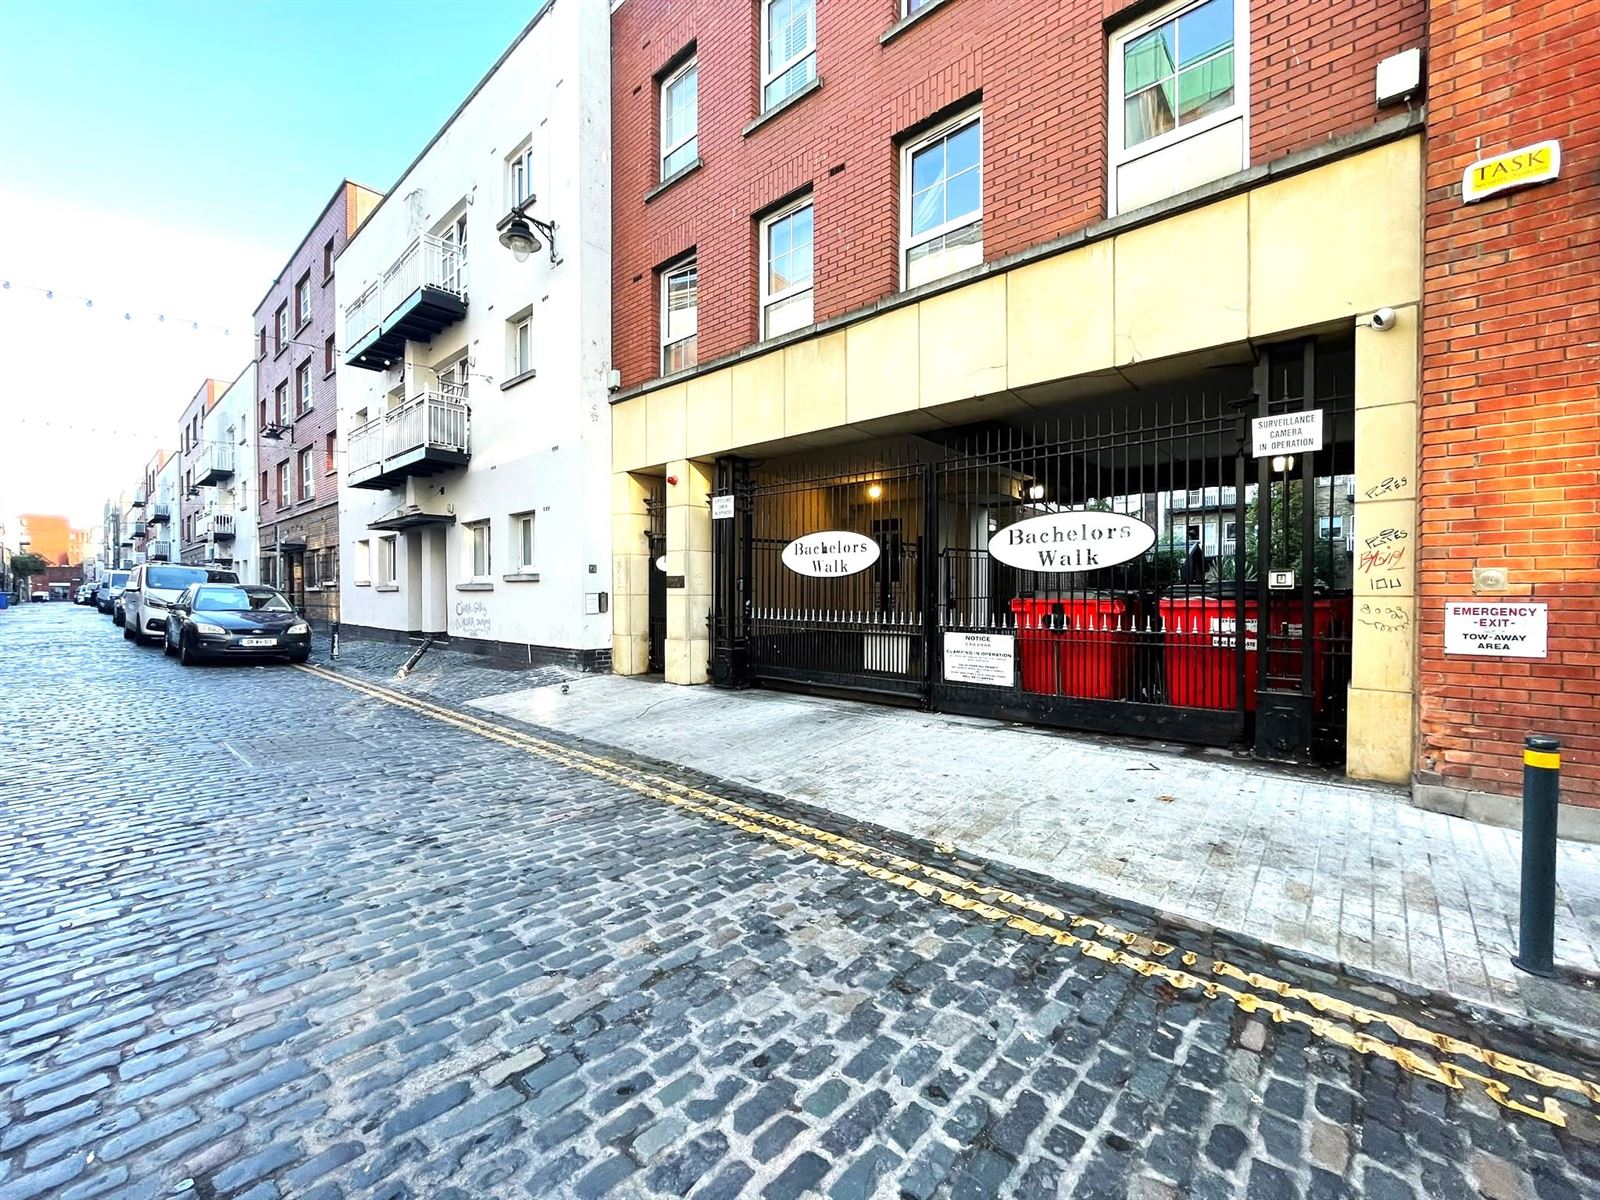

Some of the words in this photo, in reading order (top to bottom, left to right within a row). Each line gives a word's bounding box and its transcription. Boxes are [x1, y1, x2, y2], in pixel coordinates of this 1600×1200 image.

[1474, 149, 1545, 181] TASK
[1258, 414, 1316, 430] SURVEILLANCE
[1269, 427, 1303, 439] CAMERA
[1259, 443, 1267, 451] IN
[1271, 438, 1314, 450] OPERATION
[1008, 524, 1132, 546] Bachelors
[794, 540, 868, 556] Bachelors
[1038, 548, 1100, 567] Walk
[812, 559, 848, 573] Walk
[1453, 607, 1537, 617] EMERGENCY
[1462, 633, 1527, 642] TOW-AWAY
